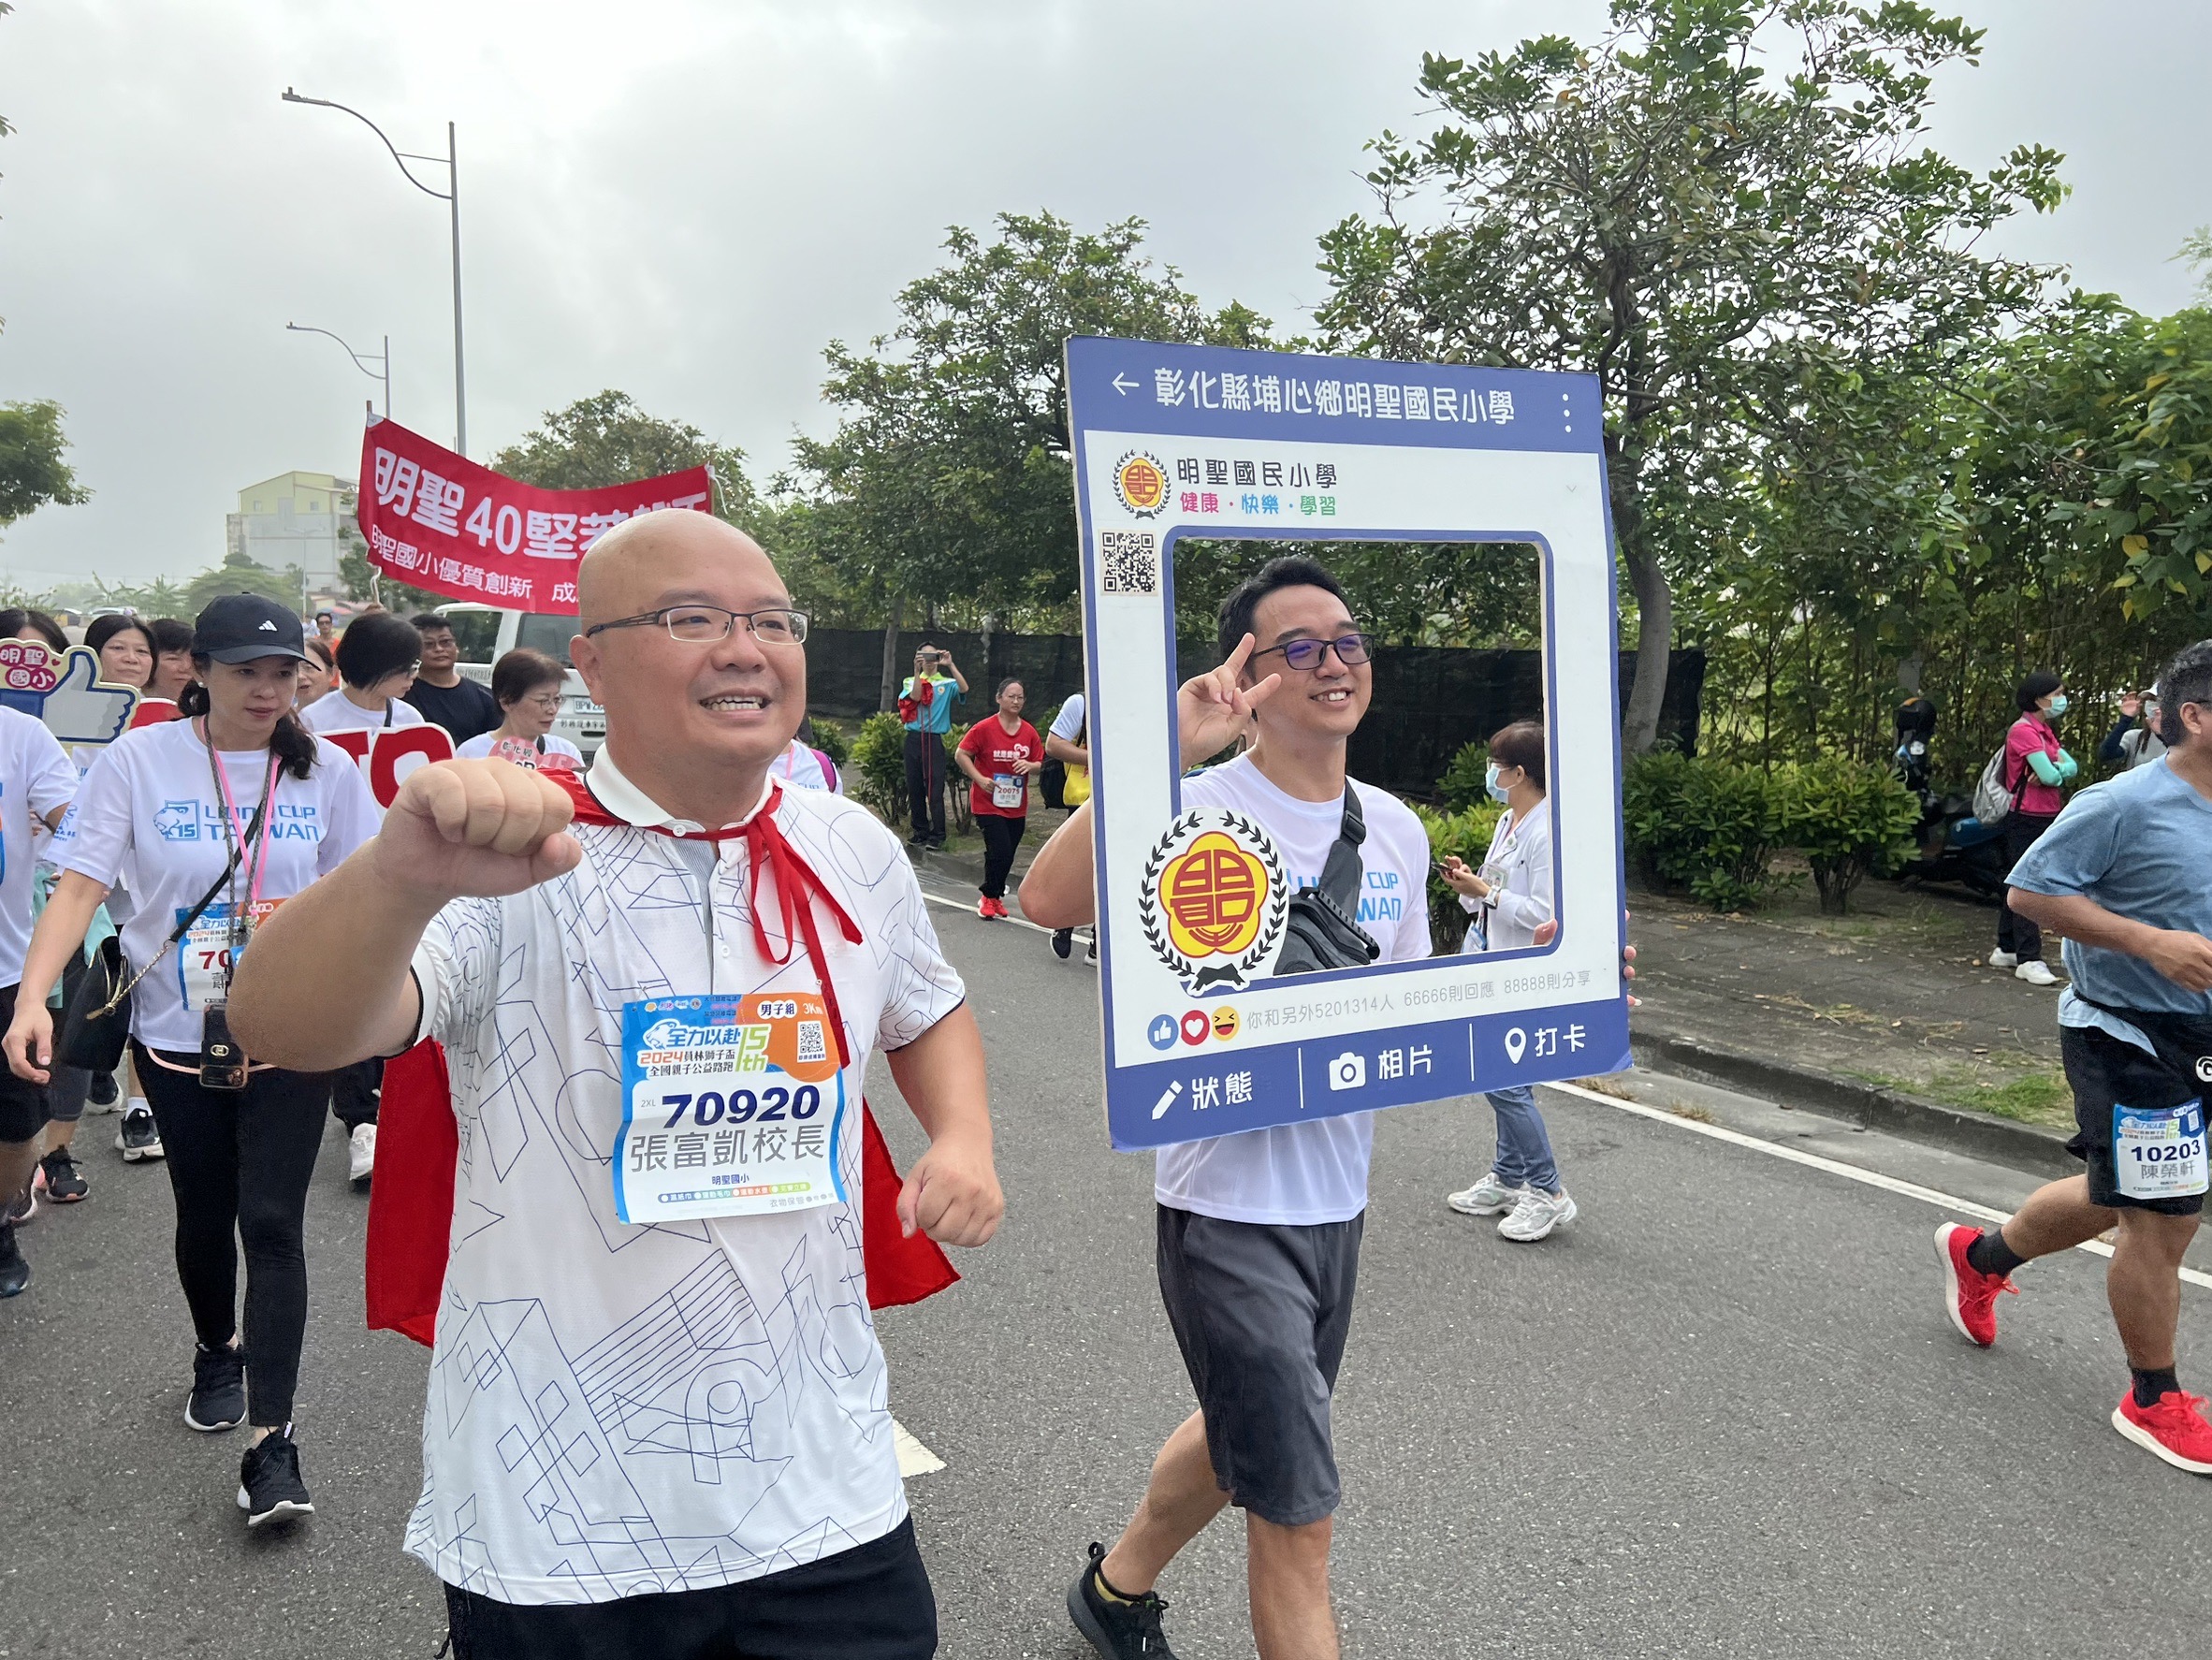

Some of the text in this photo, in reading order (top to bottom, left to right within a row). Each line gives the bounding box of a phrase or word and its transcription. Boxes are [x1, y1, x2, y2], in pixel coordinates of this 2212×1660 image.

[1154, 367, 1515, 426] 彰化縣埔心鄉明聖國民小學
[1177, 458, 1337, 488] 明聖國民小學
[375, 446, 706, 561] 明聖40堅若
[1180, 491, 1336, 517] 健康 快樂 學習
[371, 524, 579, 604] 明聖國小優質創新 成
[0, 648, 45, 664] 明聖
[9, 669, 53, 688] 國小
[278, 805, 316, 820] CUP
[178, 823, 196, 837] 15
[204, 823, 320, 841] TAWAN
[1366, 872, 1399, 889] CUP
[1357, 897, 1402, 922] WAN
[760, 1002, 796, 1017] 男子組
[803, 1002, 823, 1015] 3Km
[1246, 969, 1592, 1030] 你和另外5201314人 66666則回應 88888則分享
[667, 1027, 741, 1048] 全力以赴
[1534, 1024, 1587, 1057] 打卡
[640, 1049, 735, 1065] 2024員林獅子盃
[1378, 1044, 1433, 1080] 相片
[649, 1062, 734, 1077] 全國親子公益路跑
[1192, 1070, 1253, 1111] 狀態
[641, 1085, 821, 1129] 2XL 70920
[631, 1124, 825, 1172] 張富凱校長
[2131, 1139, 2201, 1162] 10203
[711, 1174, 749, 1186] 明聖國小
[2141, 1160, 2195, 1179] 陳榮軒
